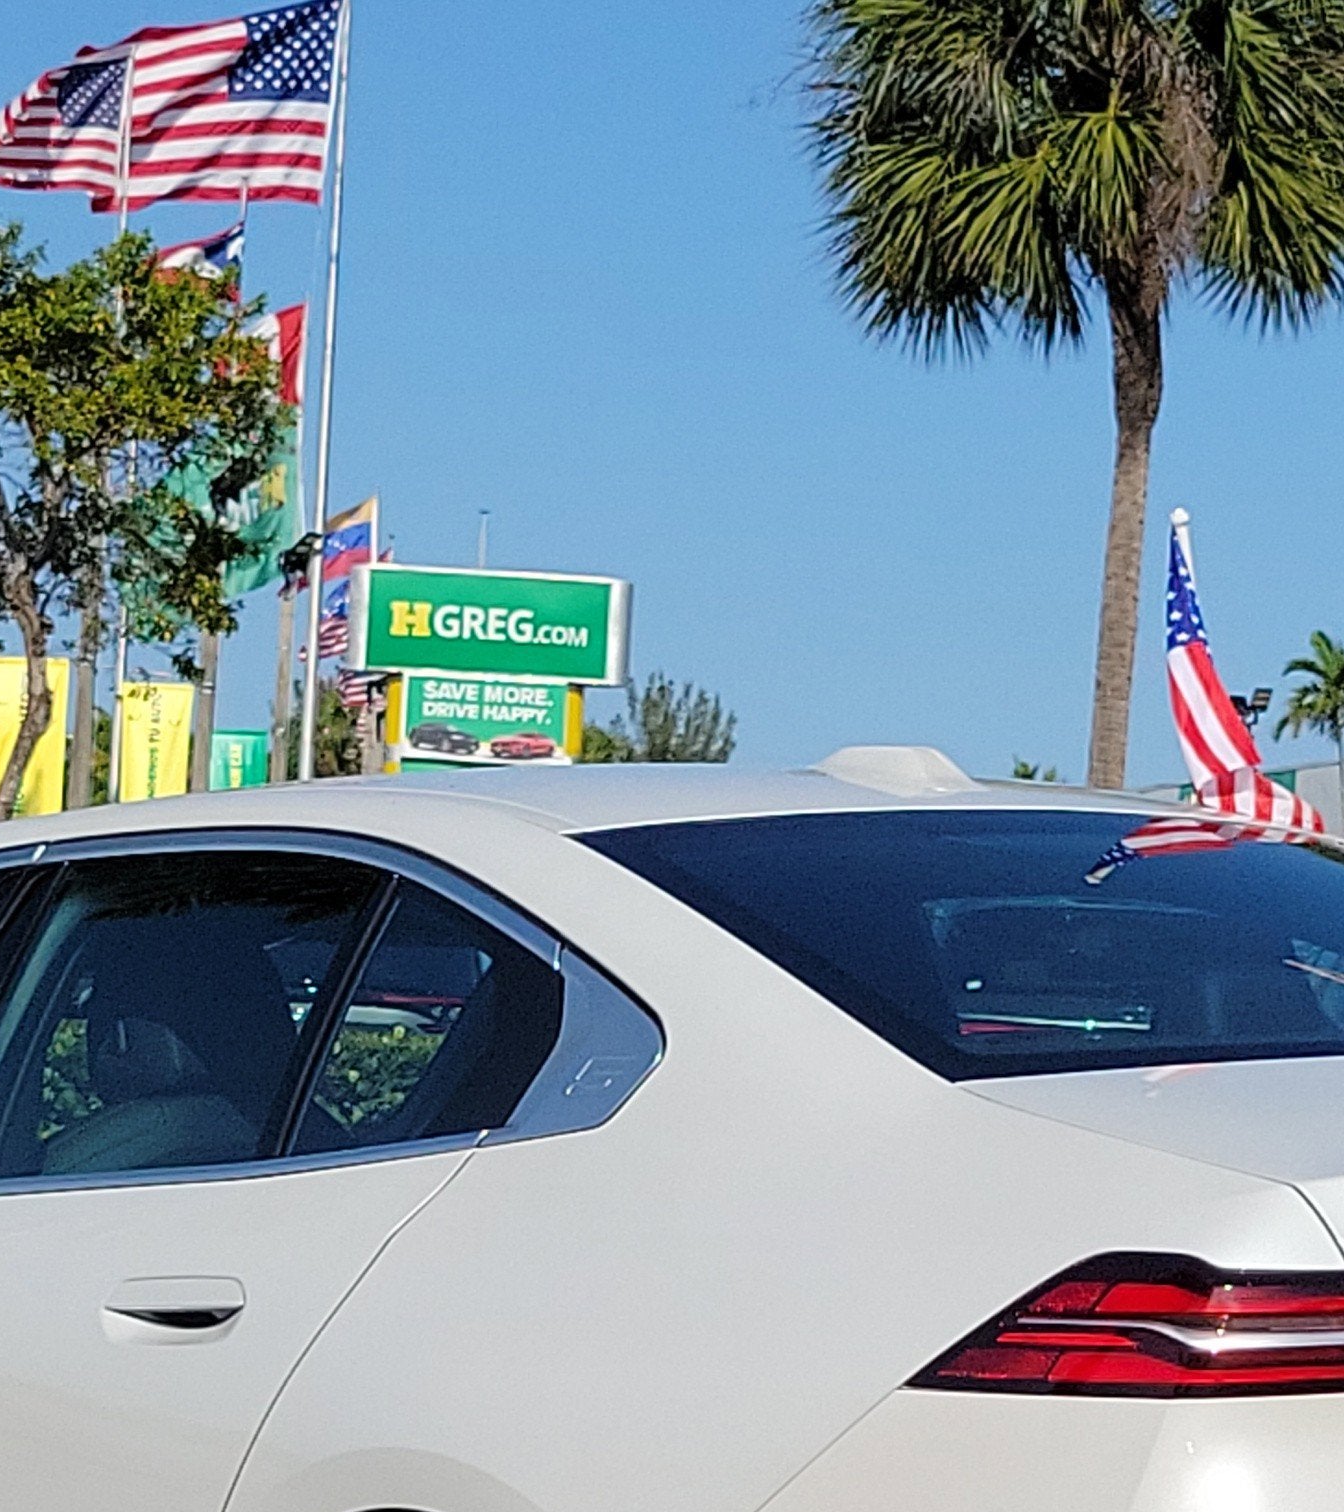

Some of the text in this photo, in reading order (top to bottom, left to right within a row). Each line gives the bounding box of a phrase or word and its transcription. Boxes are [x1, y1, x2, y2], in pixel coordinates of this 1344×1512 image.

[423, 680, 554, 708] SAVE MORE.
[422, 701, 552, 725] DRIVE HAPPY.
